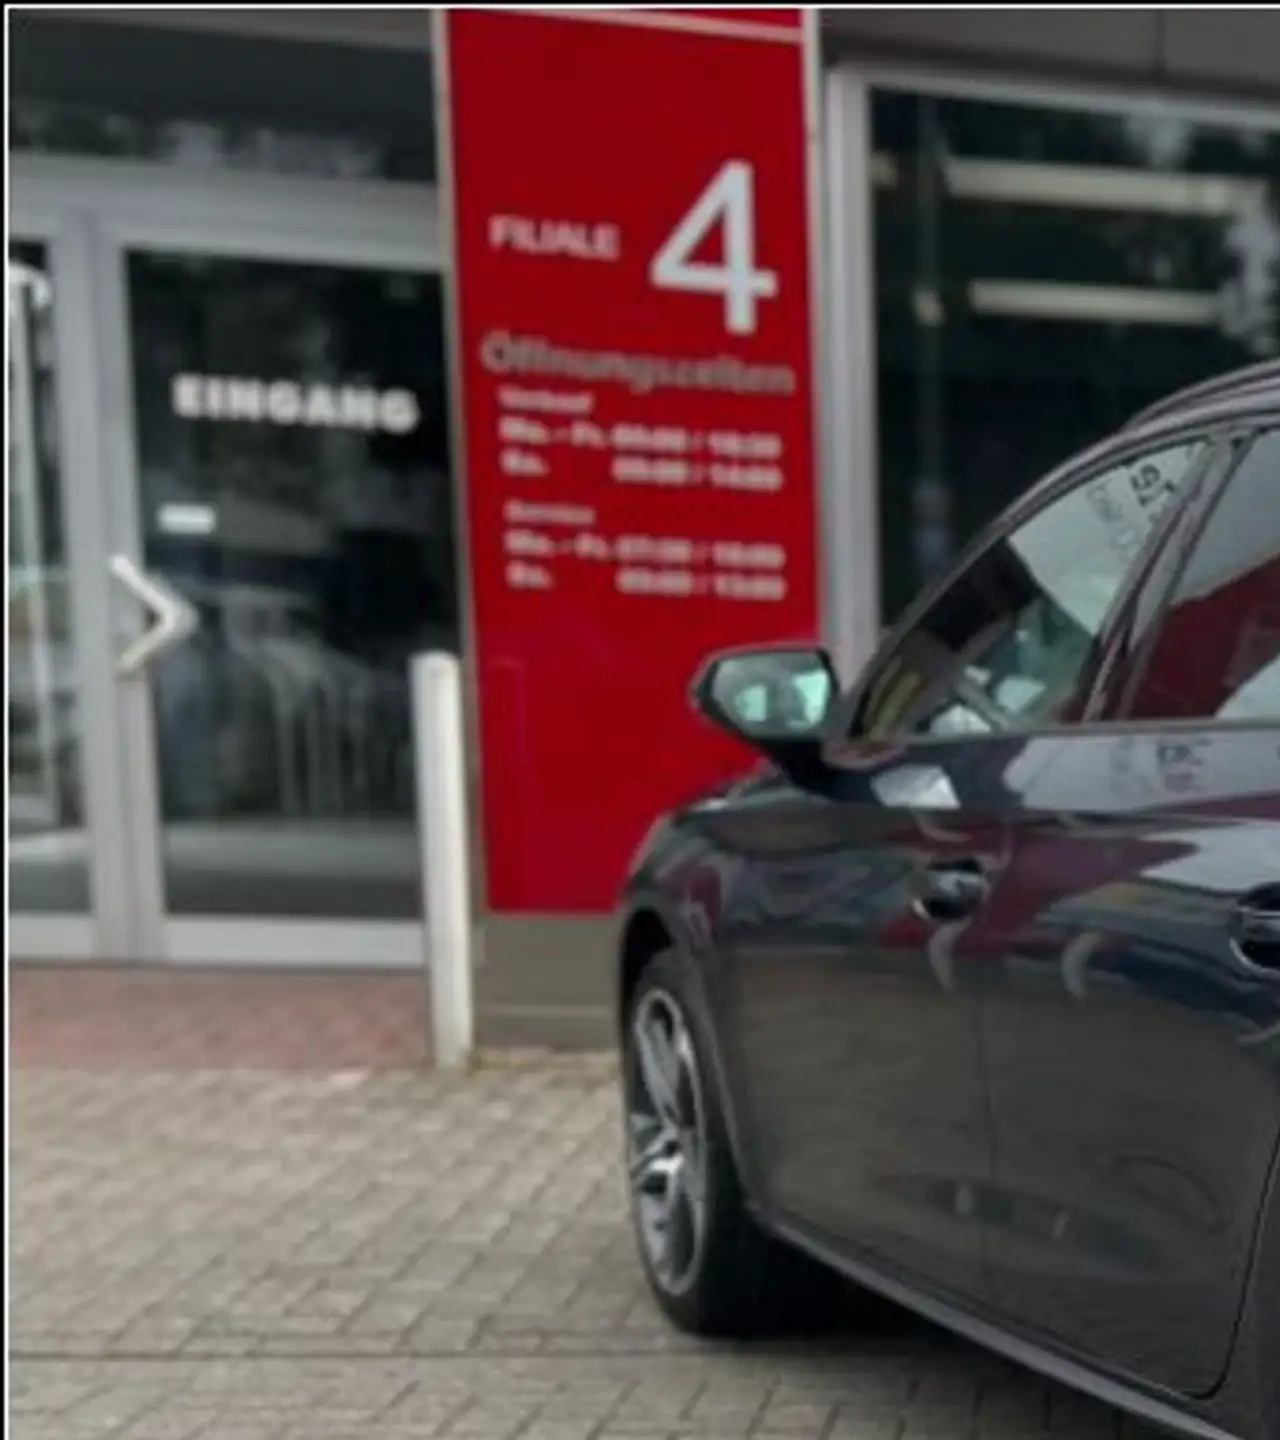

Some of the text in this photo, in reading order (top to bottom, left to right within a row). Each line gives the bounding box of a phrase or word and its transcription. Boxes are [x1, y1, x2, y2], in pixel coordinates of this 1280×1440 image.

[488, 158, 779, 336] FILIALE 4
[172, 371, 420, 435] EINGANG
